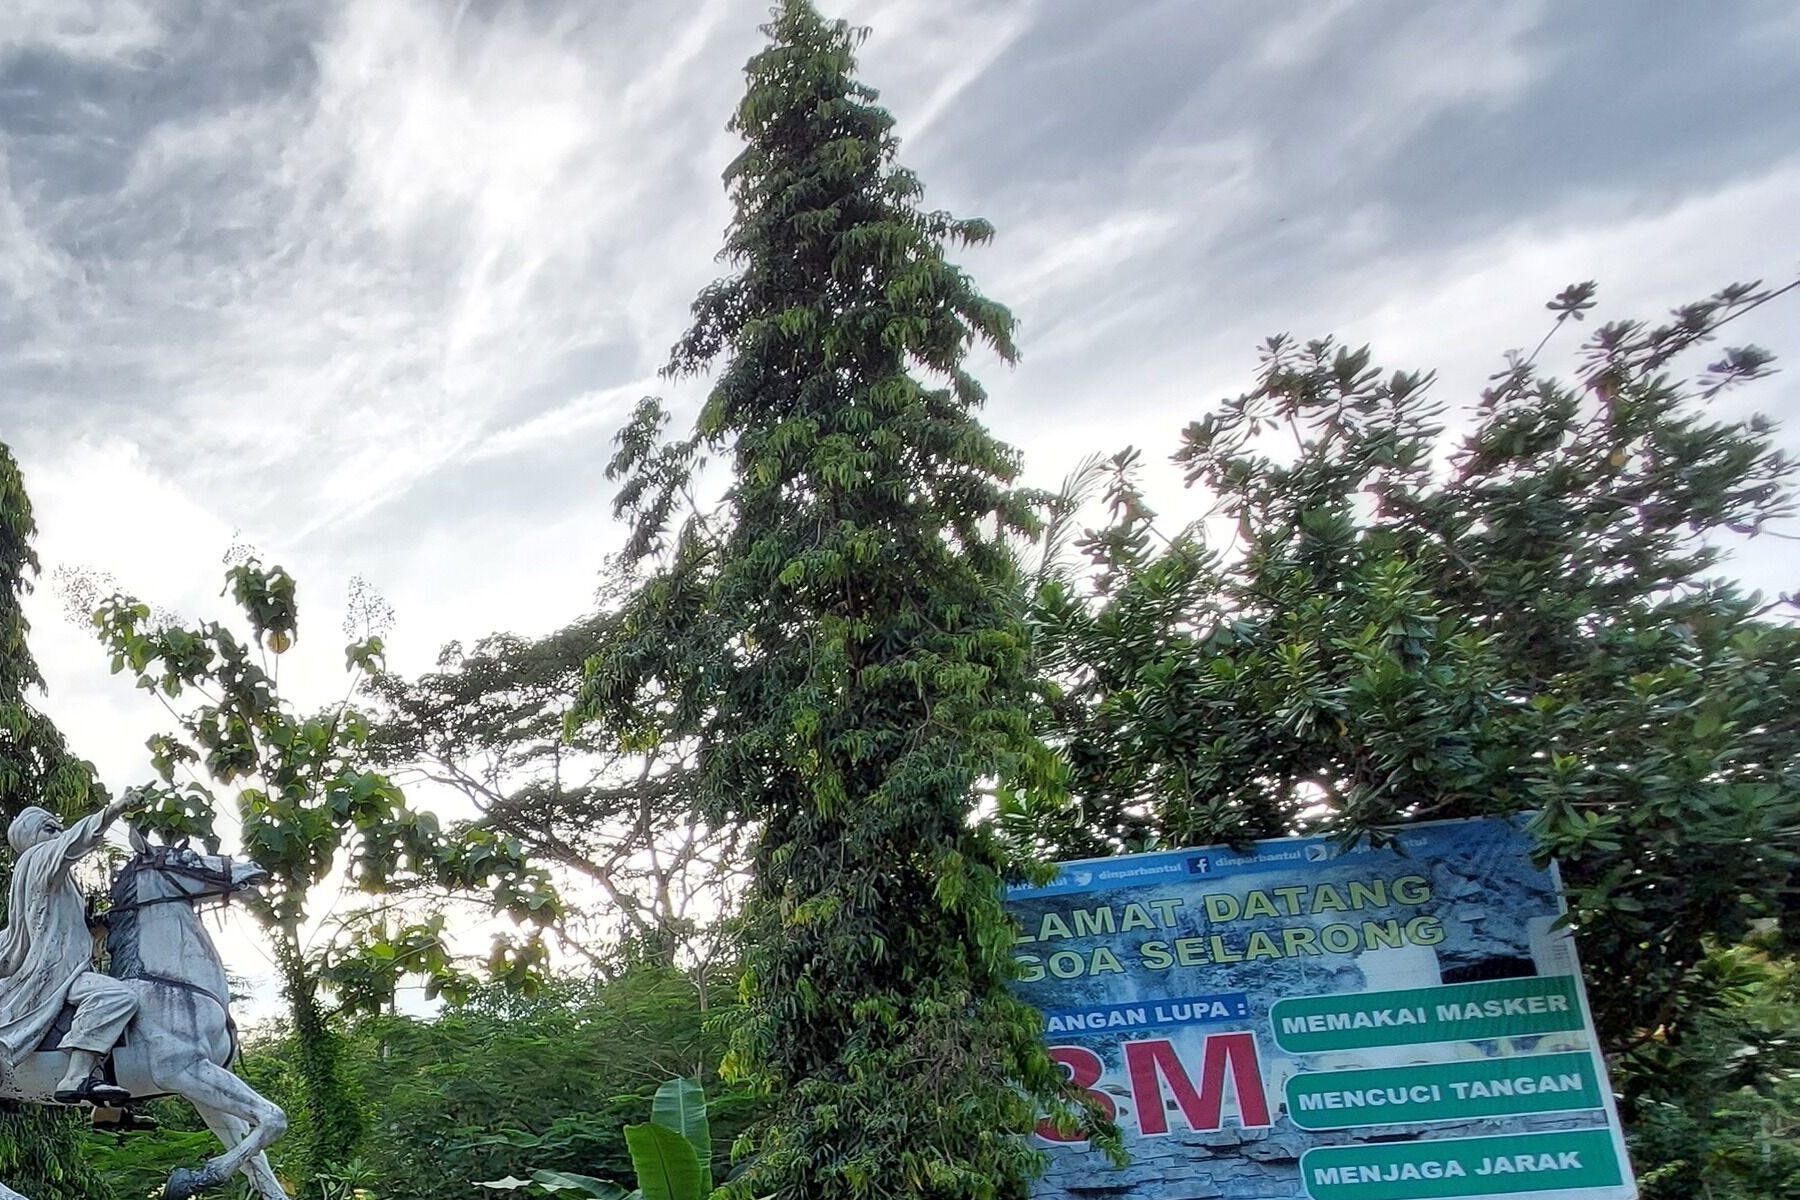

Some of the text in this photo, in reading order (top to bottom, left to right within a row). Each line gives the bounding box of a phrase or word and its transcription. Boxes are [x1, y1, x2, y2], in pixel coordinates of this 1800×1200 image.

[1098, 863, 1182, 880] dinparbantul
[1214, 850, 1301, 867] dinparbantul
[1204, 875, 1433, 923] DATANG
[1014, 915, 1445, 983] GOA SELARONG
[1046, 1007, 1147, 1032] ANGAN
[1156, 1001, 1229, 1023] LUPA
[1281, 994, 1570, 1034] MEMAKAI MASKER
[1297, 1072, 1583, 1111] MENCUCI TANGAN
[1313, 1150, 1583, 1186] MENJAGA JARAK
